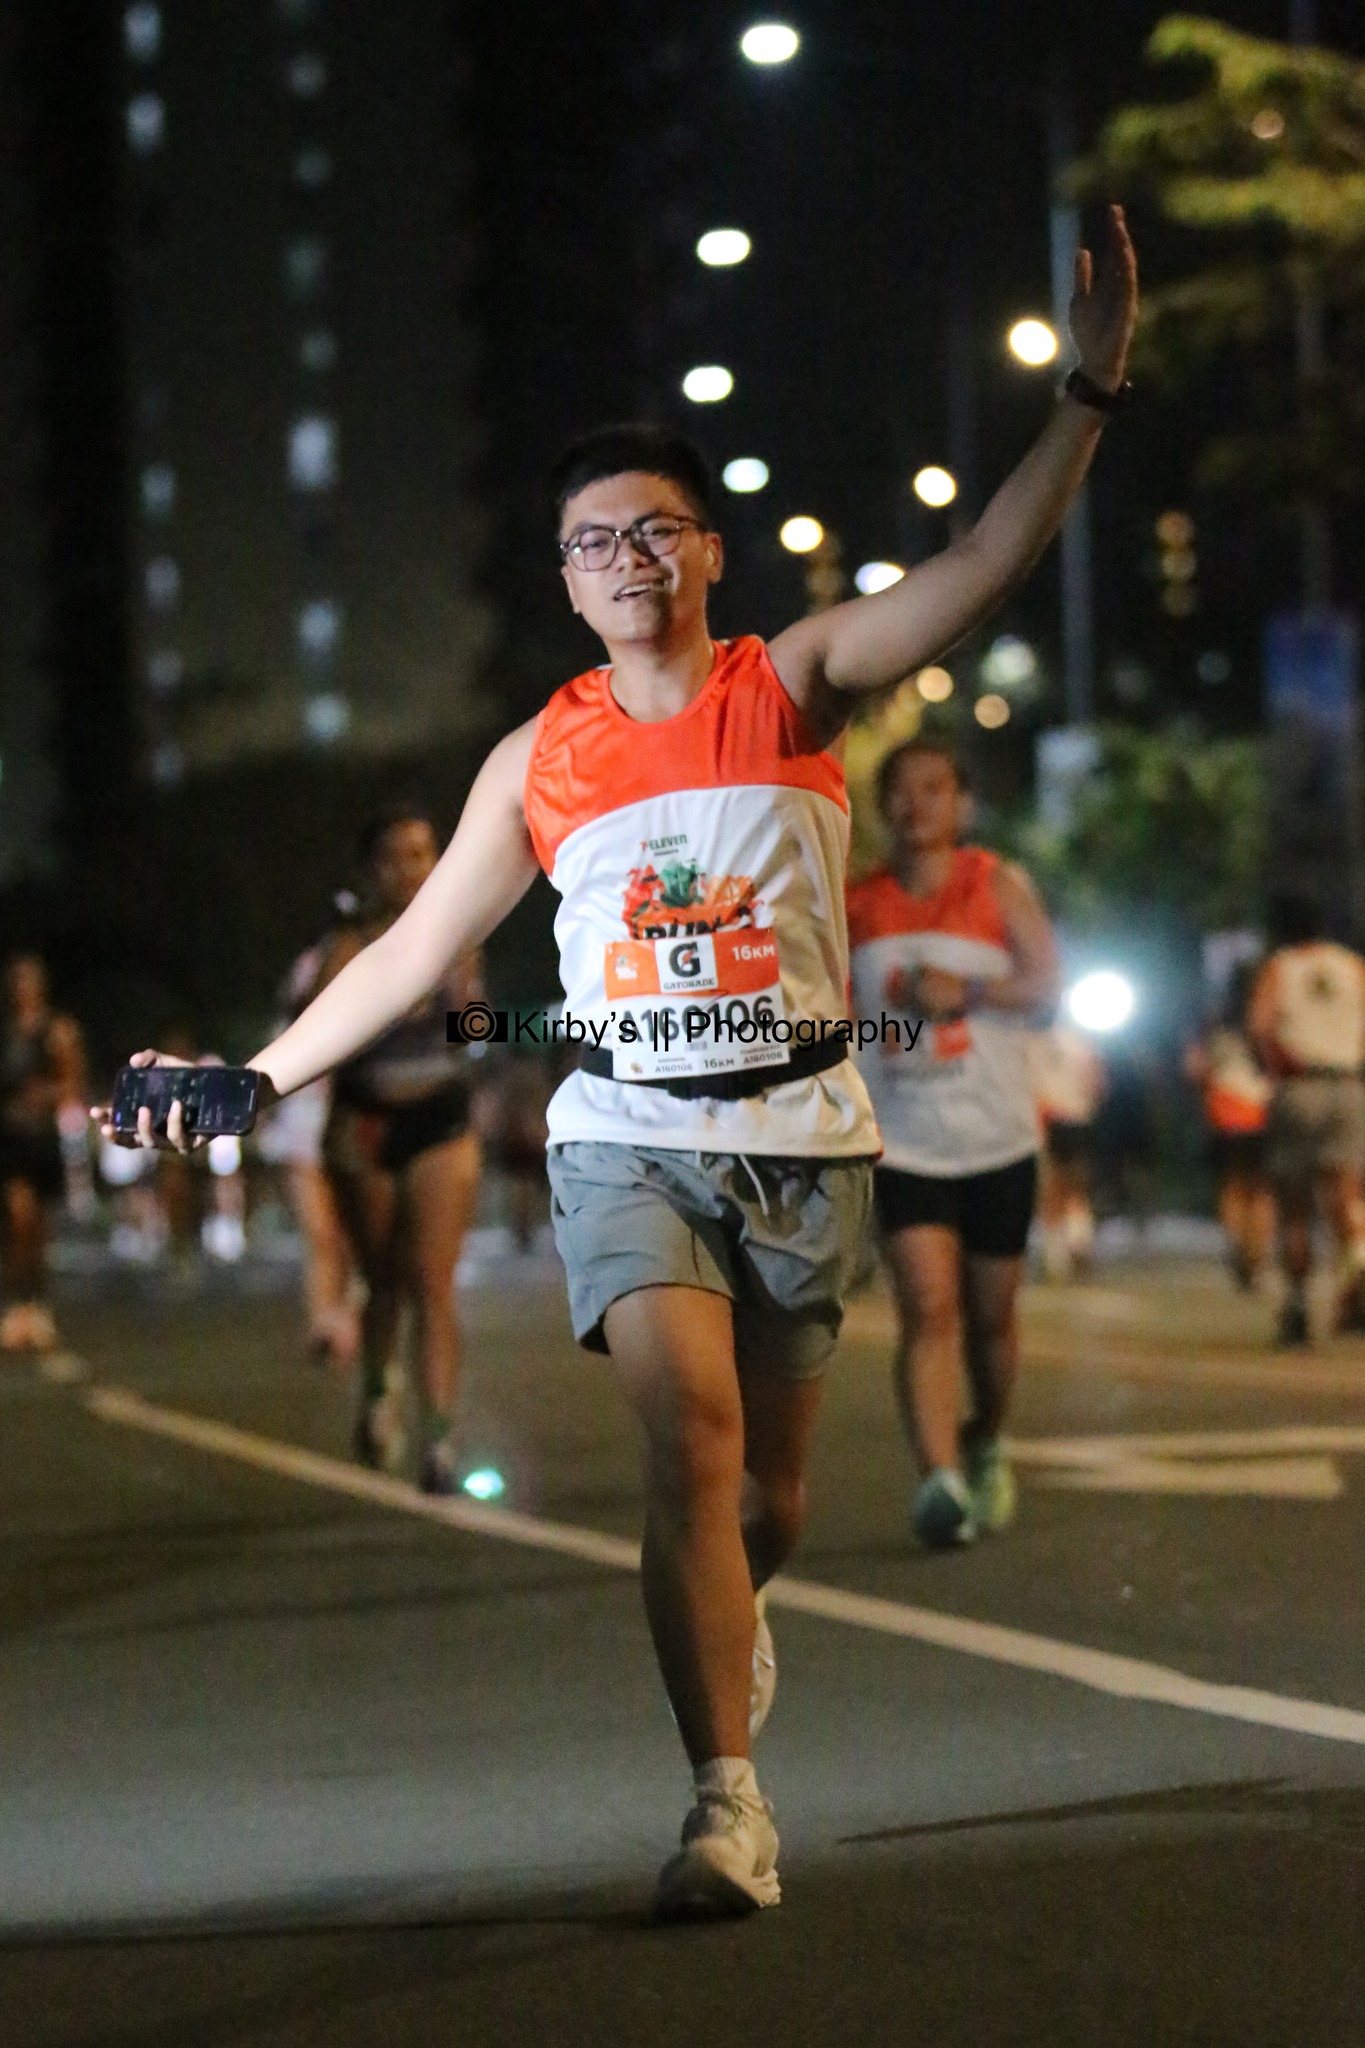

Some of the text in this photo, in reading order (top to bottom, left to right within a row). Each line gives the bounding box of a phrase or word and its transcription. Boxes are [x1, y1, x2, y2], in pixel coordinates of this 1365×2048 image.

[668, 941, 701, 978] G
[731, 944, 775, 961] 16KM
[663, 978, 716, 990] GATORADE
[621, 995, 775, 1043] A160106
